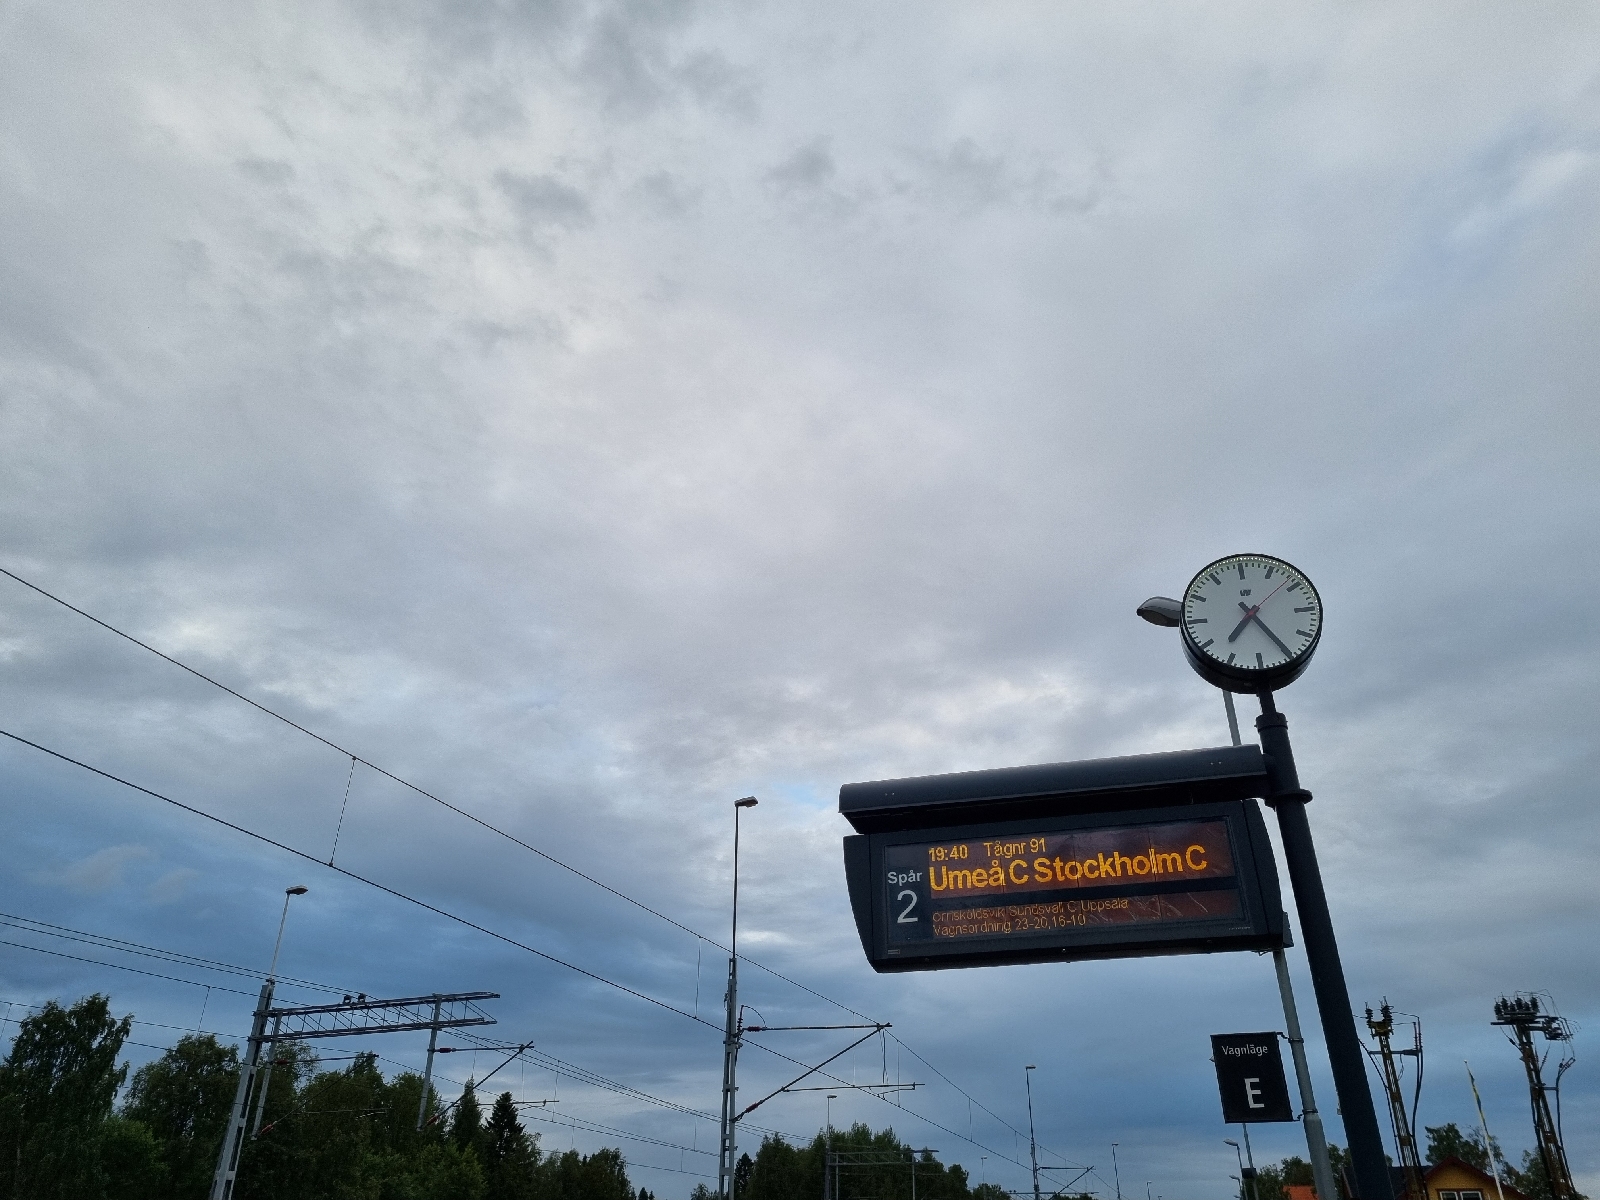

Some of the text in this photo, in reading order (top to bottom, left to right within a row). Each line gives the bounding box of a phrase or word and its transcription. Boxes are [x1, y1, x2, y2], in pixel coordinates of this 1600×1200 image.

[929, 838, 1046, 862] 19:40 Tågnr 91
[929, 844, 1207, 891] Umeå C Stockholm C
[887, 870, 922, 886] Spår
[896, 890, 918, 923] 2
[1066, 900, 1076, 912] C
[1081, 898, 1128, 912] Uppsala
[933, 921, 1011, 937] Vagnsordning
[1222, 1044, 1268, 1057] Vagnläge
[1244, 1078, 1265, 1109] E
